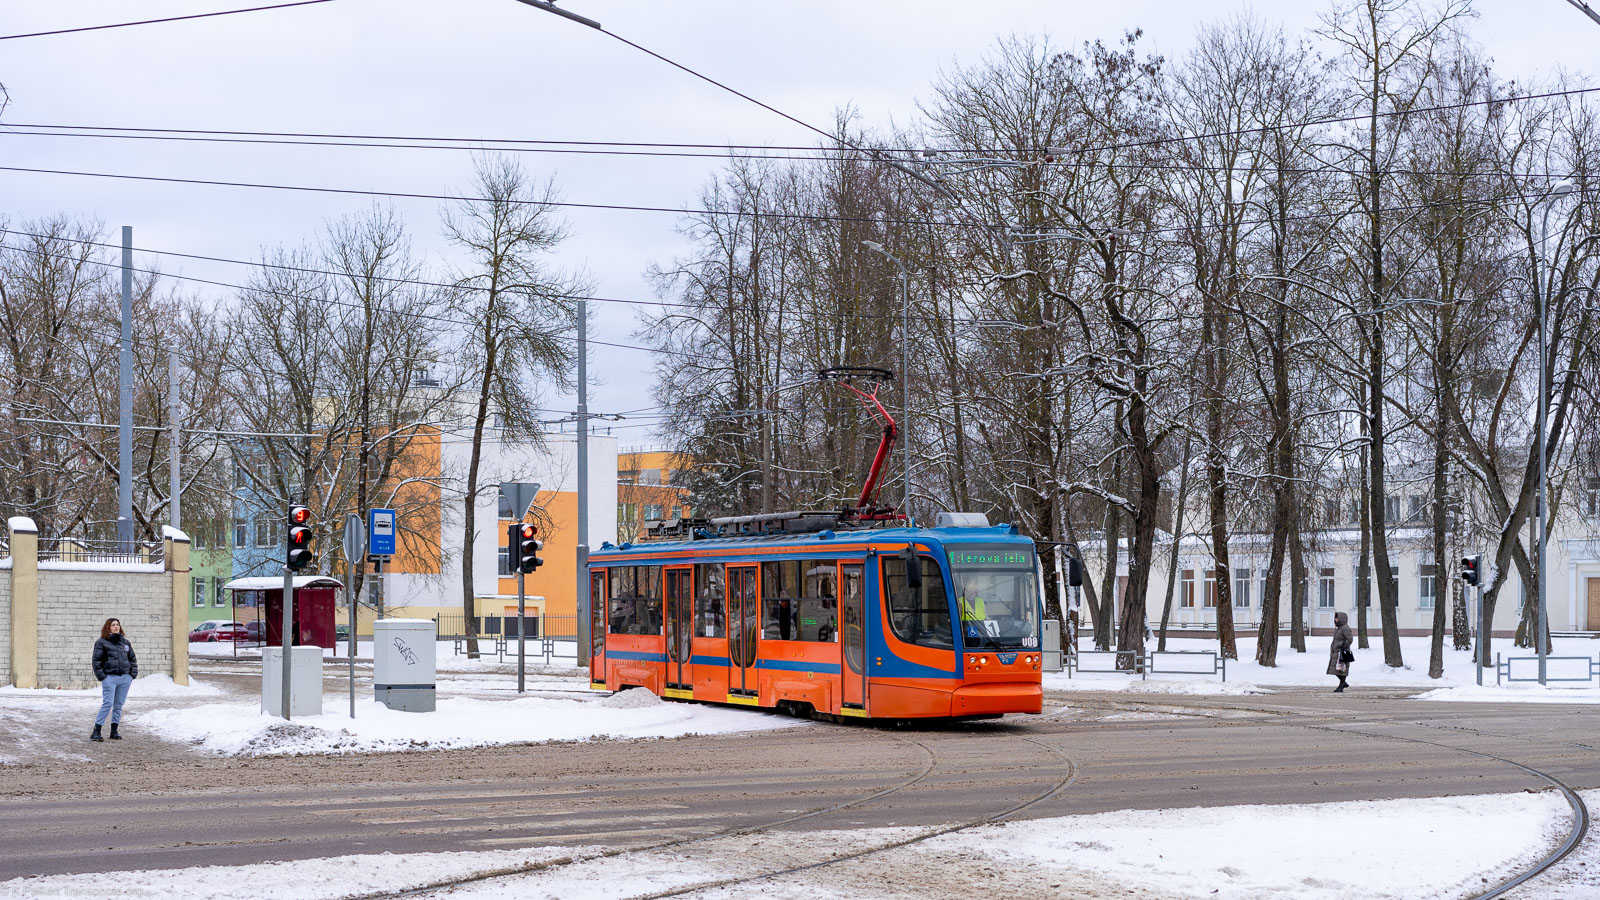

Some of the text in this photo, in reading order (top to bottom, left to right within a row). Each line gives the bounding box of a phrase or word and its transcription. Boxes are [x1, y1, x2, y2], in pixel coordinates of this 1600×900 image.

[297, 510, 305, 522] 9
[1004, 552, 1025, 563] iela
[1022, 637, 1038, 647] U08
